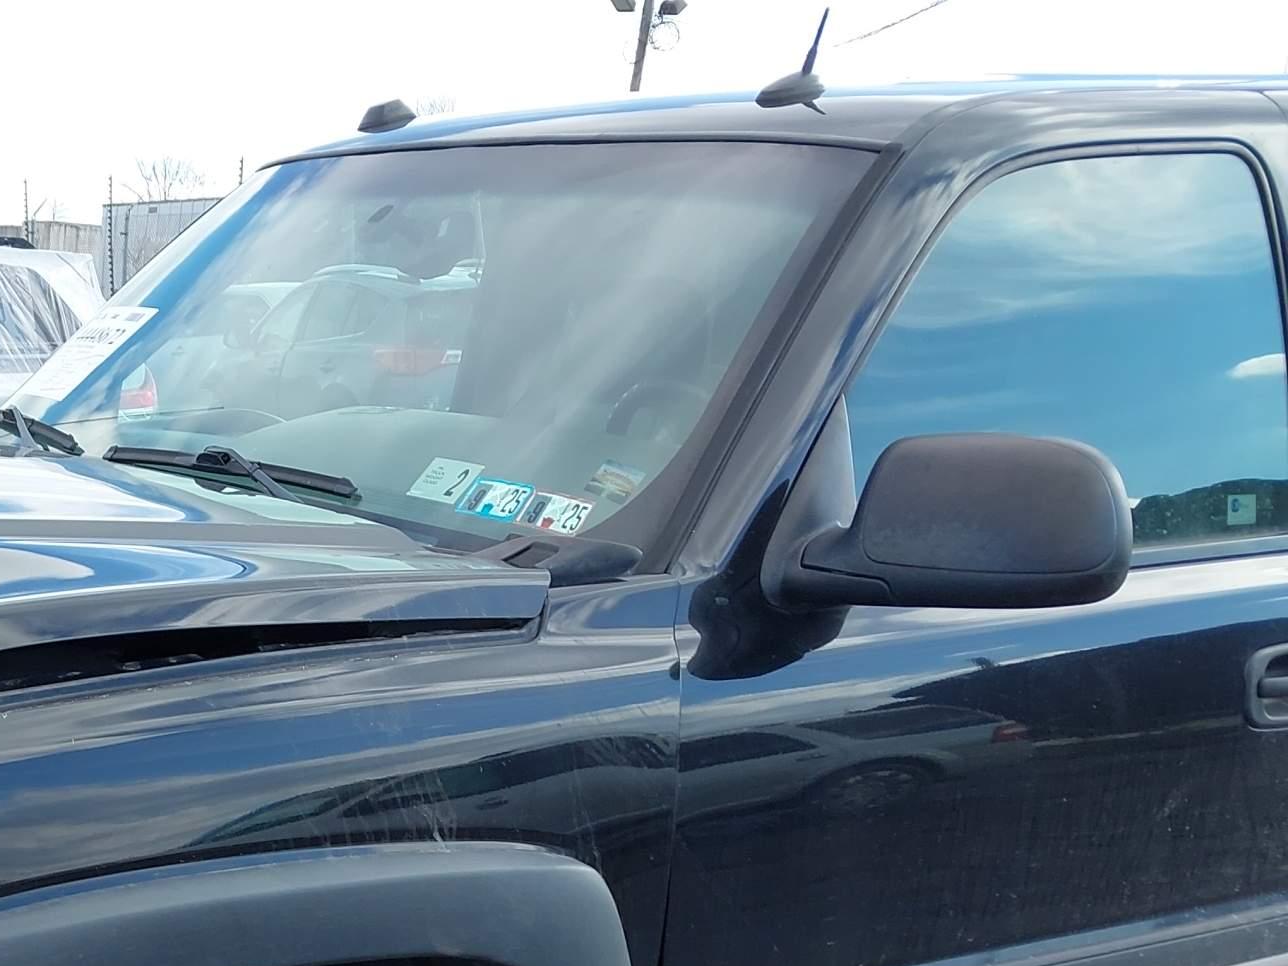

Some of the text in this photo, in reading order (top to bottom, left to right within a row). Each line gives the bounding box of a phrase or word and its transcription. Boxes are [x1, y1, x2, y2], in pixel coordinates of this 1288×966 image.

[444, 469, 470, 496] 2
[468, 488, 528, 514] 9 25
[527, 501, 589, 531] 9 25
